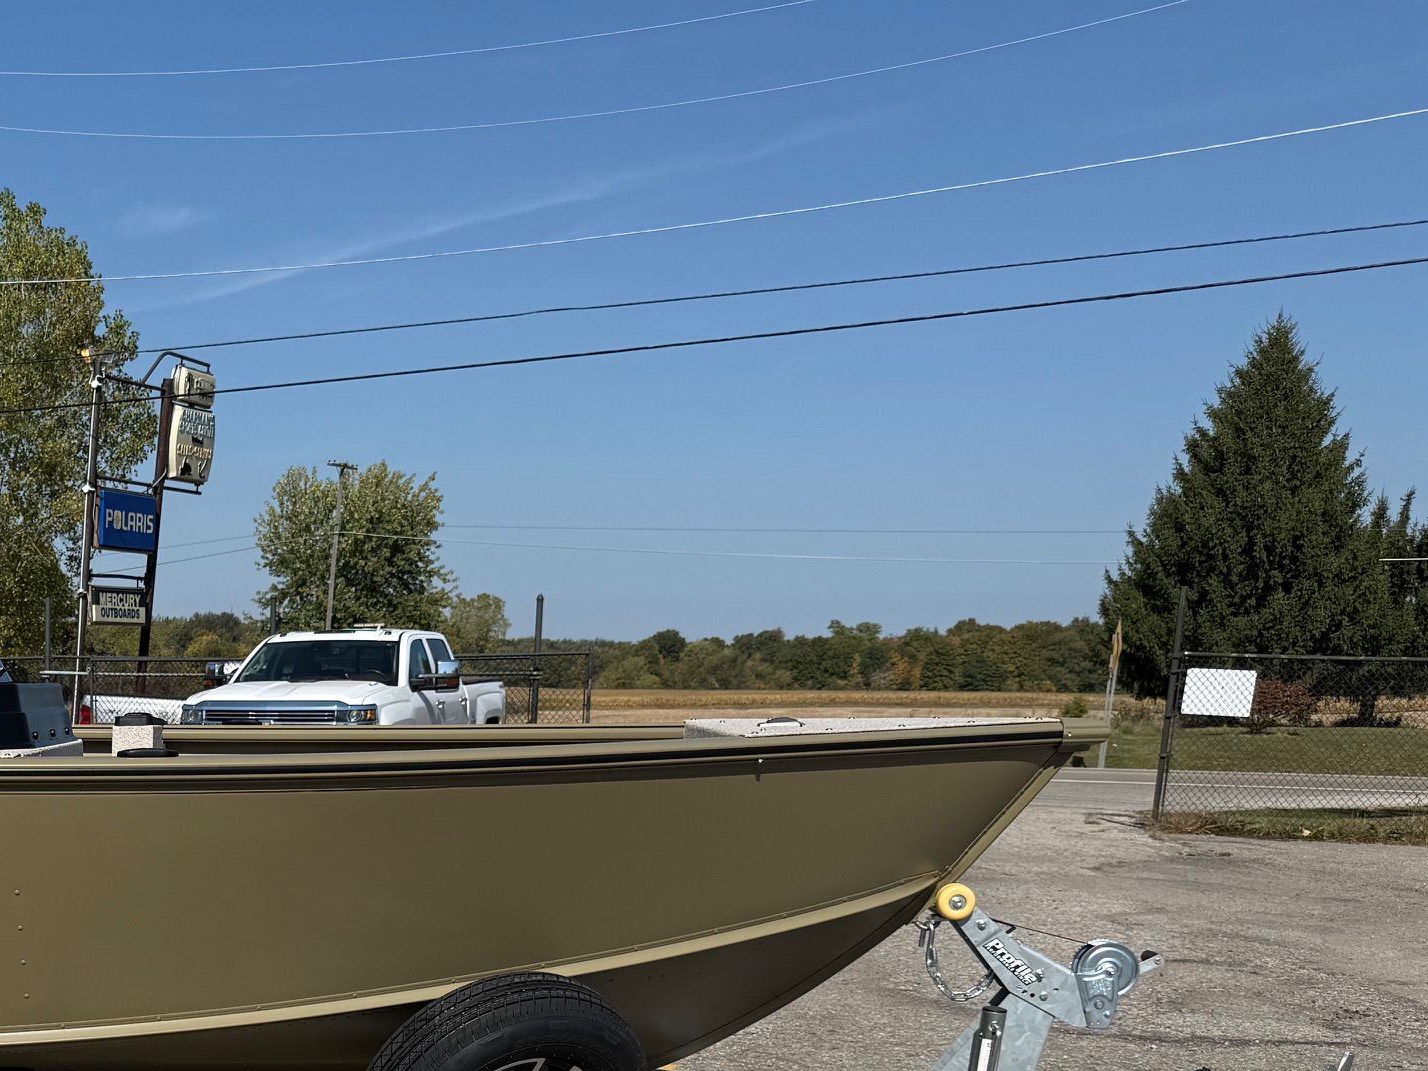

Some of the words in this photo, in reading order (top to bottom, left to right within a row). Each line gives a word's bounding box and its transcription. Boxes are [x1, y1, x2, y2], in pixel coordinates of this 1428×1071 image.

[105, 508, 154, 534] POLARIS
[99, 592, 141, 607] MERCURY
[100, 607, 141, 619] OUTBOARDS
[983, 938, 1038, 986] Profile
